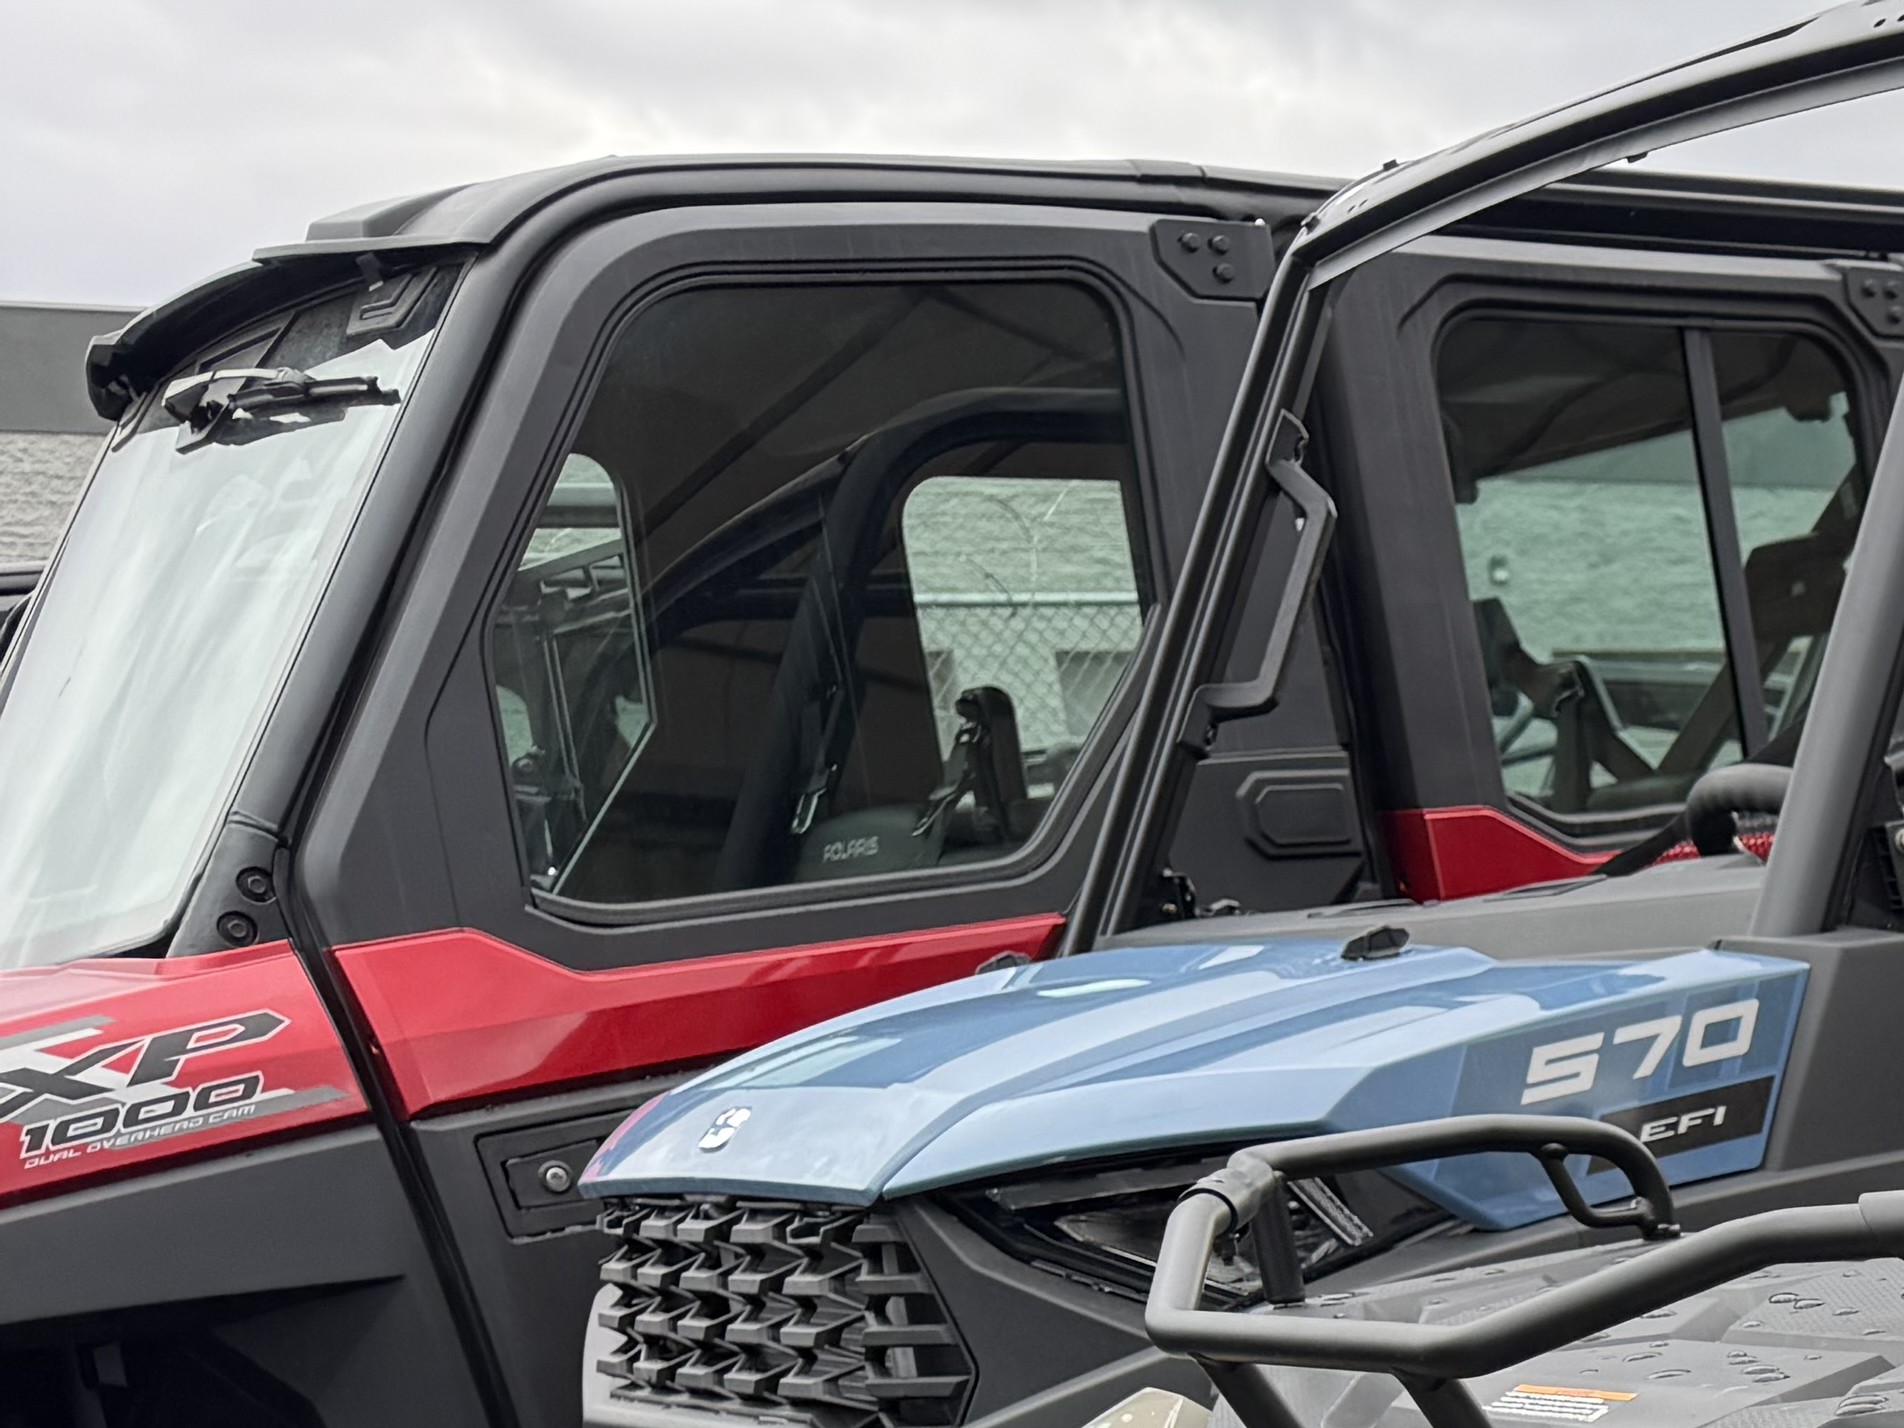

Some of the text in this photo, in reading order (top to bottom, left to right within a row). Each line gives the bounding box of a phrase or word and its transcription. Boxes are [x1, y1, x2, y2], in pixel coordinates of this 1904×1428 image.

[0, 1008, 292, 1124] XP
[1519, 997, 1761, 1106] 570
[20, 1070, 264, 1159] 1000
[24, 1103, 257, 1170] DUAL OVERHEAD CAM
[1637, 1105, 1726, 1141] EFI
